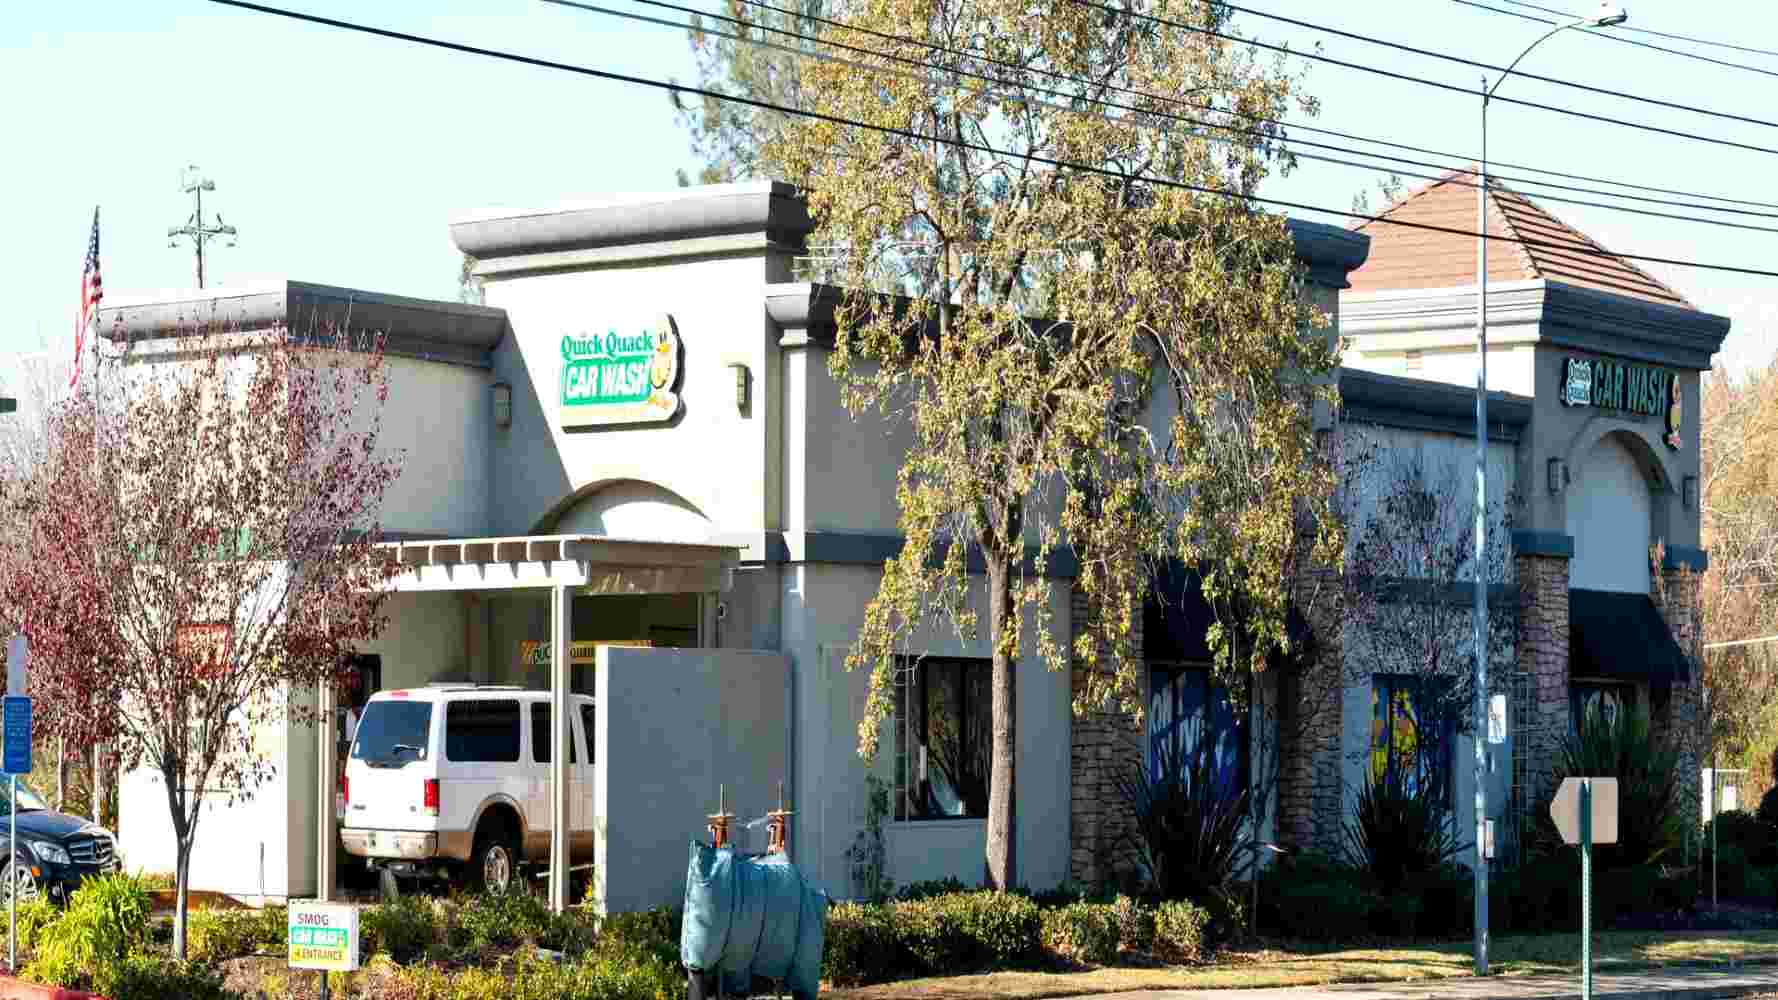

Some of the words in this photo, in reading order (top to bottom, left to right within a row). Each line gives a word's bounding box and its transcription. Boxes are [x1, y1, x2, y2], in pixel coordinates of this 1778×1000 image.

[561, 334, 603, 361] Quick
[605, 331, 654, 358] Quack
[566, 366, 599, 398] CAR
[600, 363, 650, 397] WASH
[1594, 361, 1624, 409] CAR
[1627, 366, 1666, 416] WASH
[297, 913, 329, 926] SMOG
[303, 948, 344, 961] ENTRANCE
